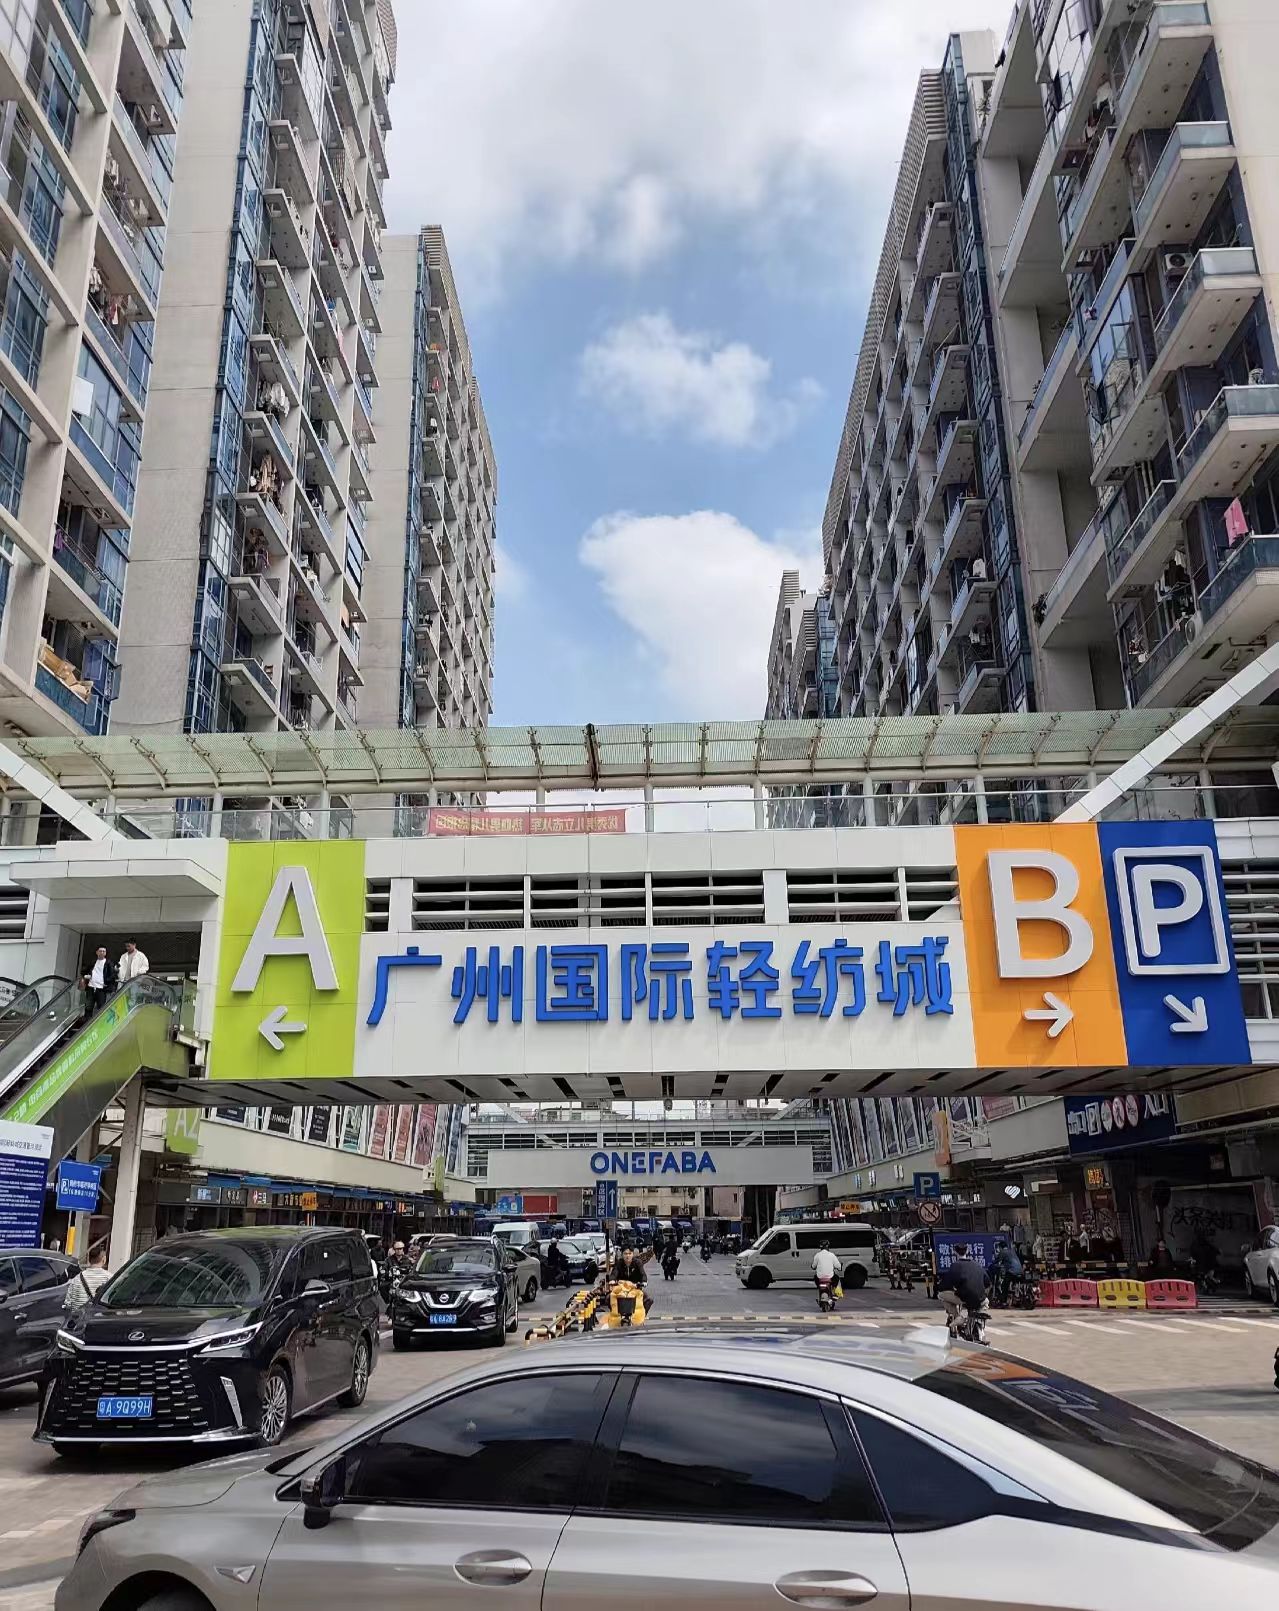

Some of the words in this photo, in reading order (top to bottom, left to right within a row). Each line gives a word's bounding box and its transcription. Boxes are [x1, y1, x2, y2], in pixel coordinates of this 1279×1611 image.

[231, 866, 340, 993] A
[987, 850, 1094, 979] B
[1131, 864, 1204, 958] P
[366, 936, 954, 1026] 广州国际轻纺城
[590, 1151, 716, 1174] ONEFABA
